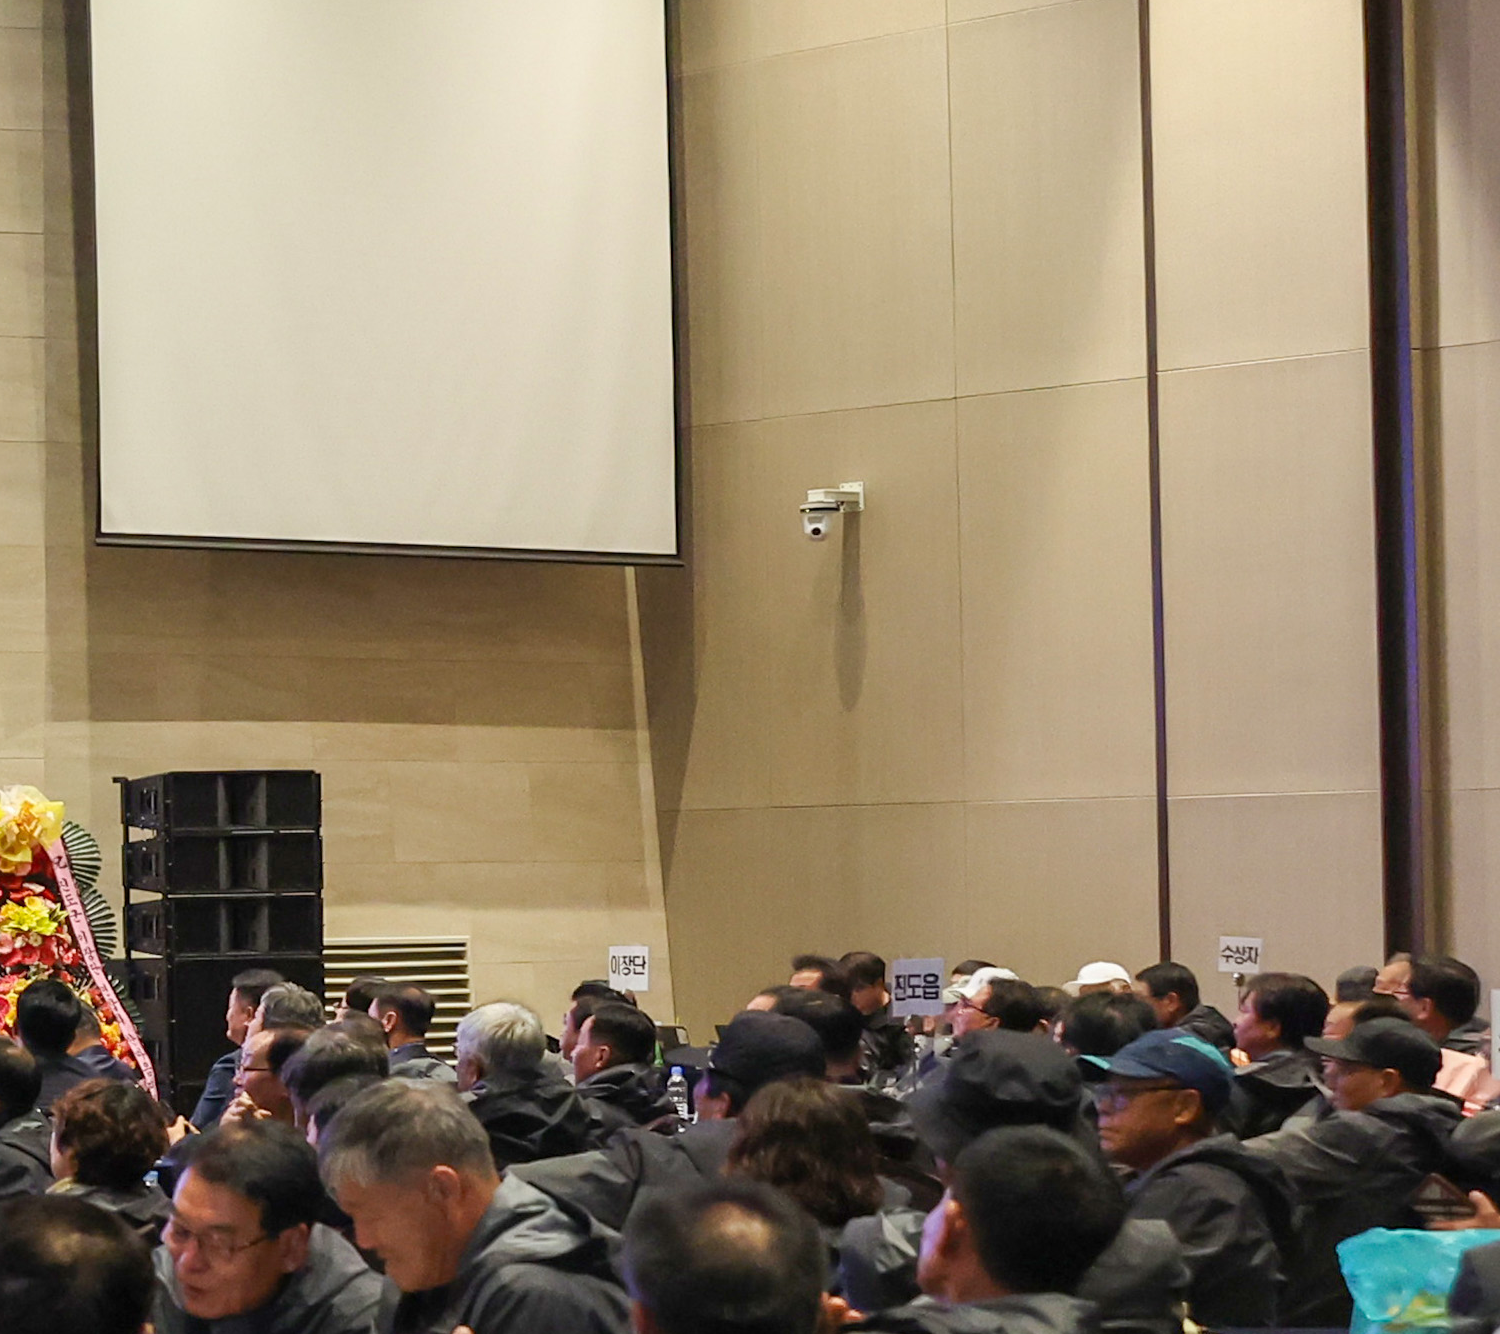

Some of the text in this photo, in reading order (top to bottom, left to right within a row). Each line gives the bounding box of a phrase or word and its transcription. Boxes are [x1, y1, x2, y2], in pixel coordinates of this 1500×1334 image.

[610, 954, 647, 975] 이장단
[1221, 946, 1259, 964] 수상자
[894, 973, 940, 1001] 진도읍
